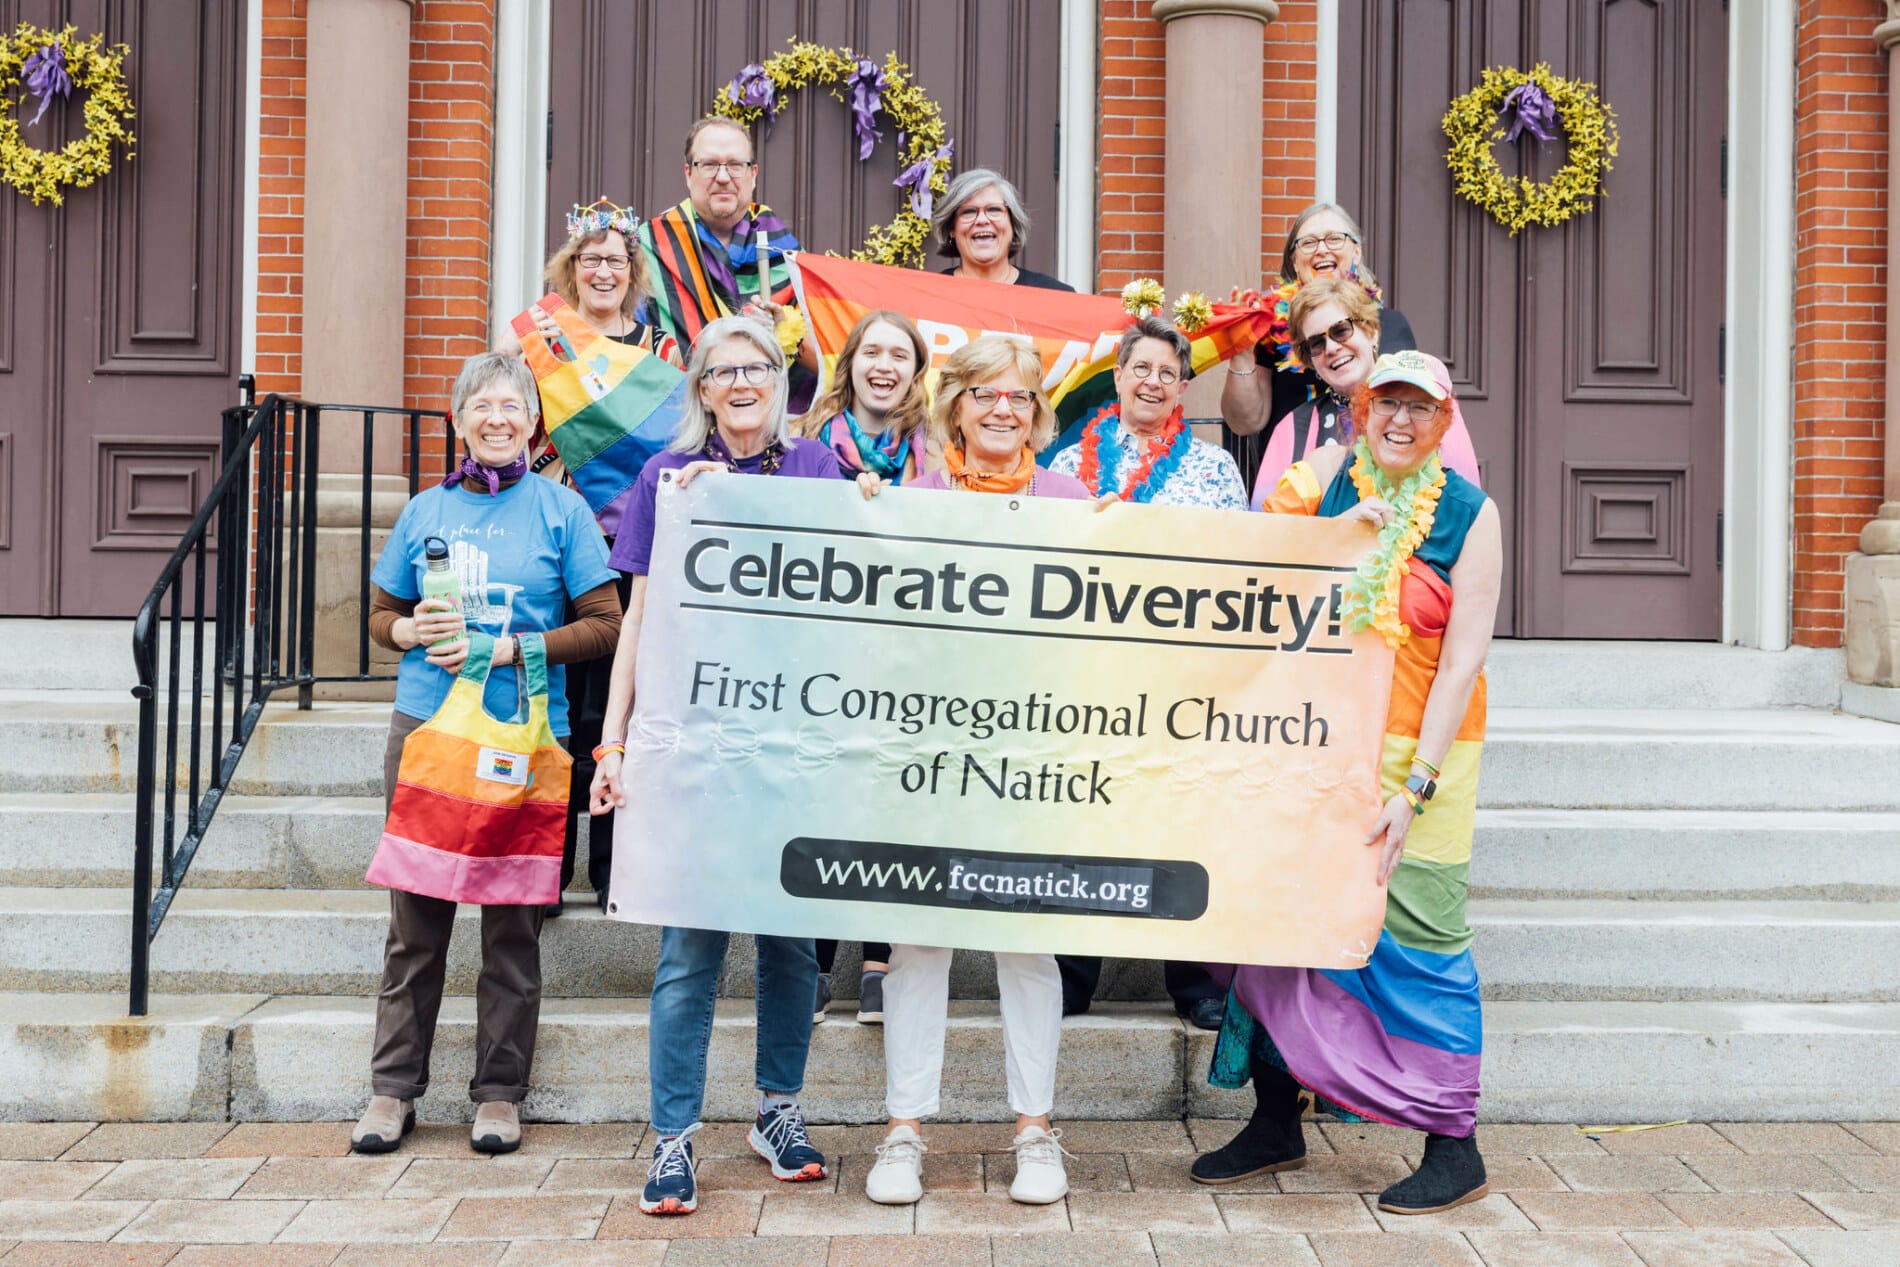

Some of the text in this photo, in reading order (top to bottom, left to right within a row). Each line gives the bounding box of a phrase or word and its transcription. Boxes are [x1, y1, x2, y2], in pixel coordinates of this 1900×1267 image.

[683, 537, 1344, 652] Celebrate Diversity!
[689, 660, 1329, 748] First Congregational Church
[900, 750, 1113, 806] of Natick
[815, 857, 1151, 907] www.fccnatick.org
